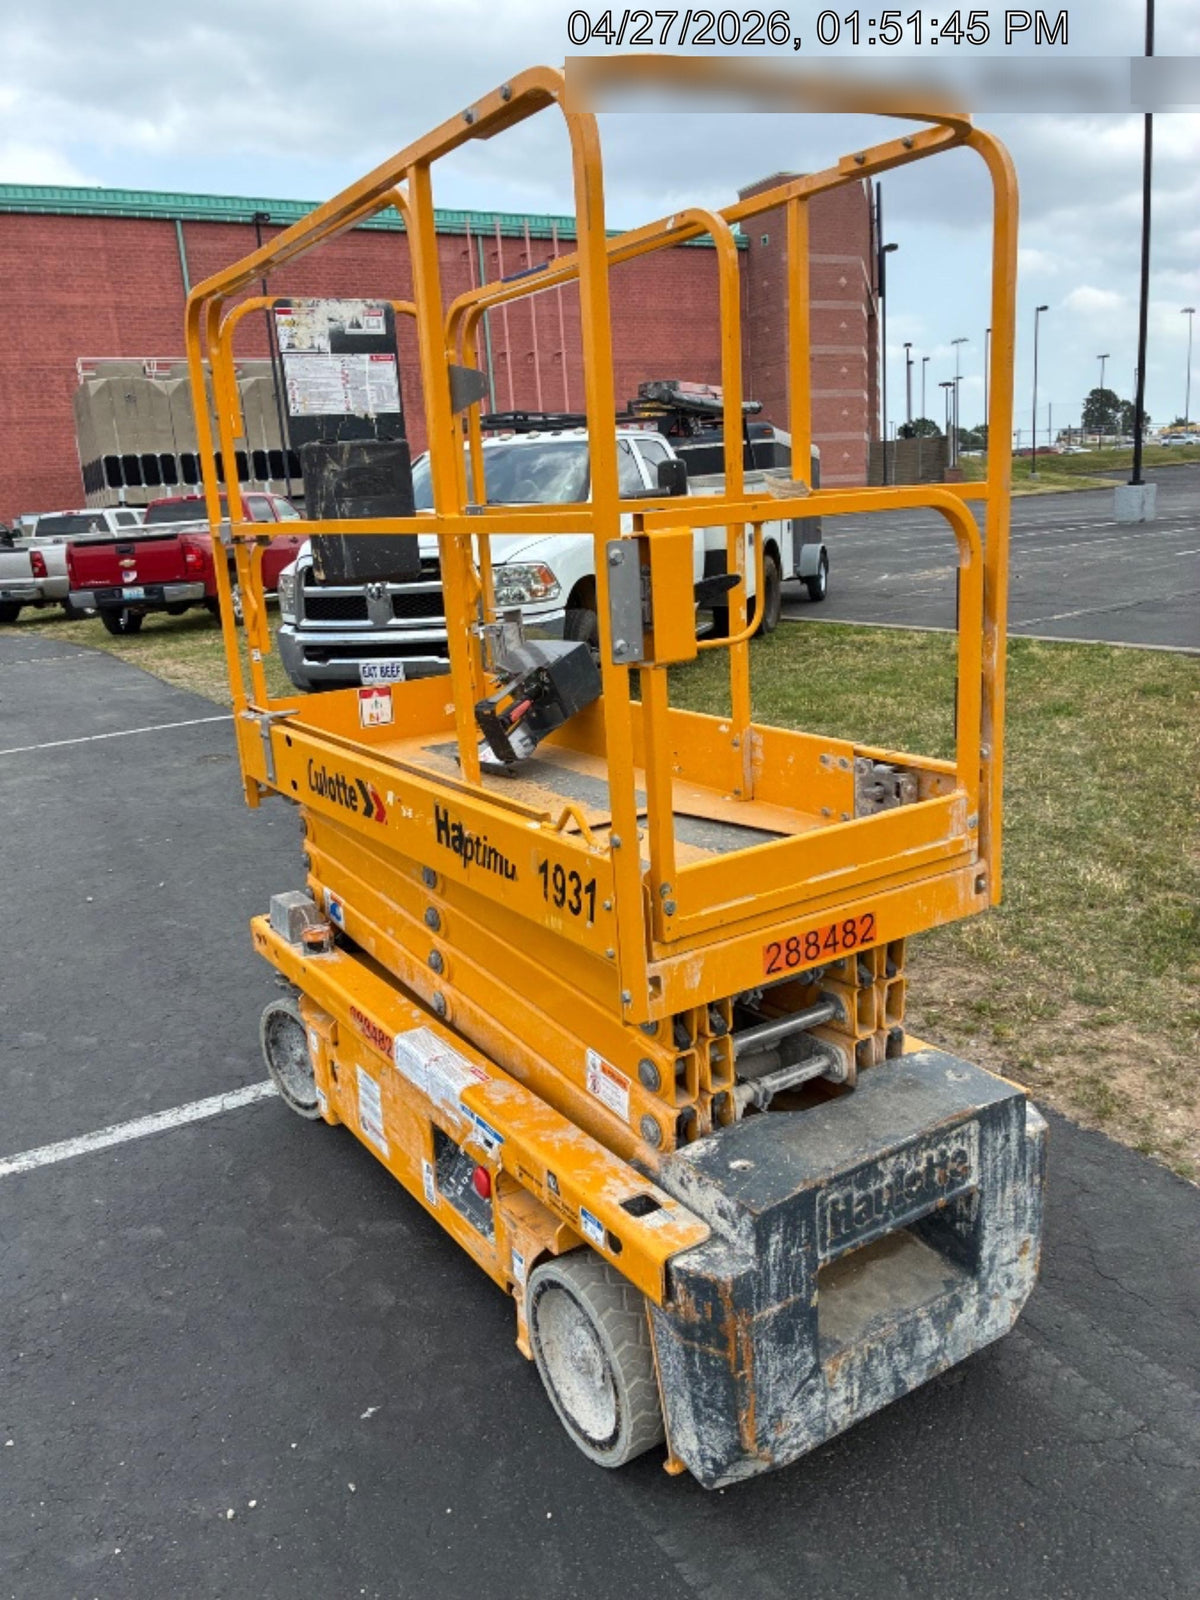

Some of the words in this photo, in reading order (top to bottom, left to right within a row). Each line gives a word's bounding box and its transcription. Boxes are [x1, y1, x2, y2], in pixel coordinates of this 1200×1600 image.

[361, 665, 378, 679] EAT
[380, 665, 401, 678] BEEF
[538, 858, 597, 923] 1931
[766, 912, 876, 975] 288482
